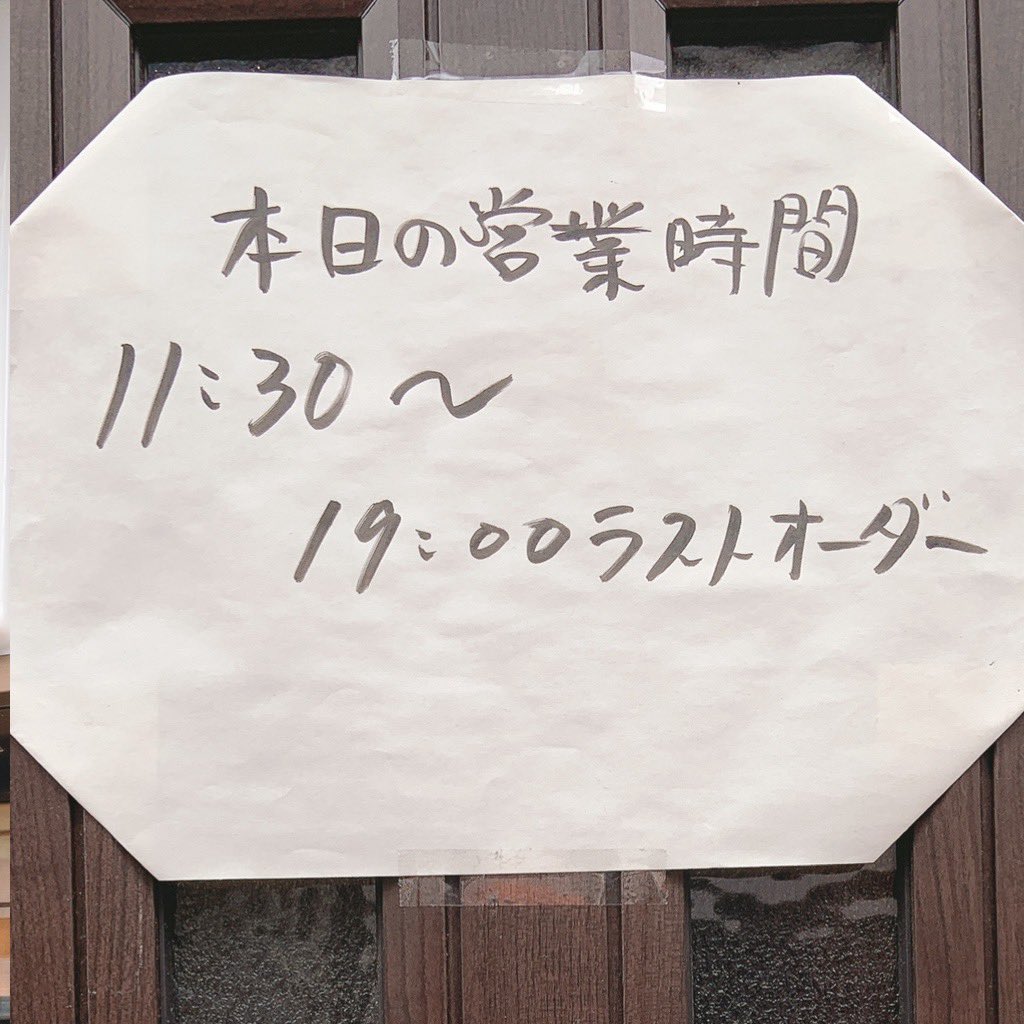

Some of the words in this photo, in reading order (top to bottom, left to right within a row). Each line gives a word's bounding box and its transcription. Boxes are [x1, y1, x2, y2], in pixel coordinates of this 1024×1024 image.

[212, 185, 858, 299] 本日の営業時間
